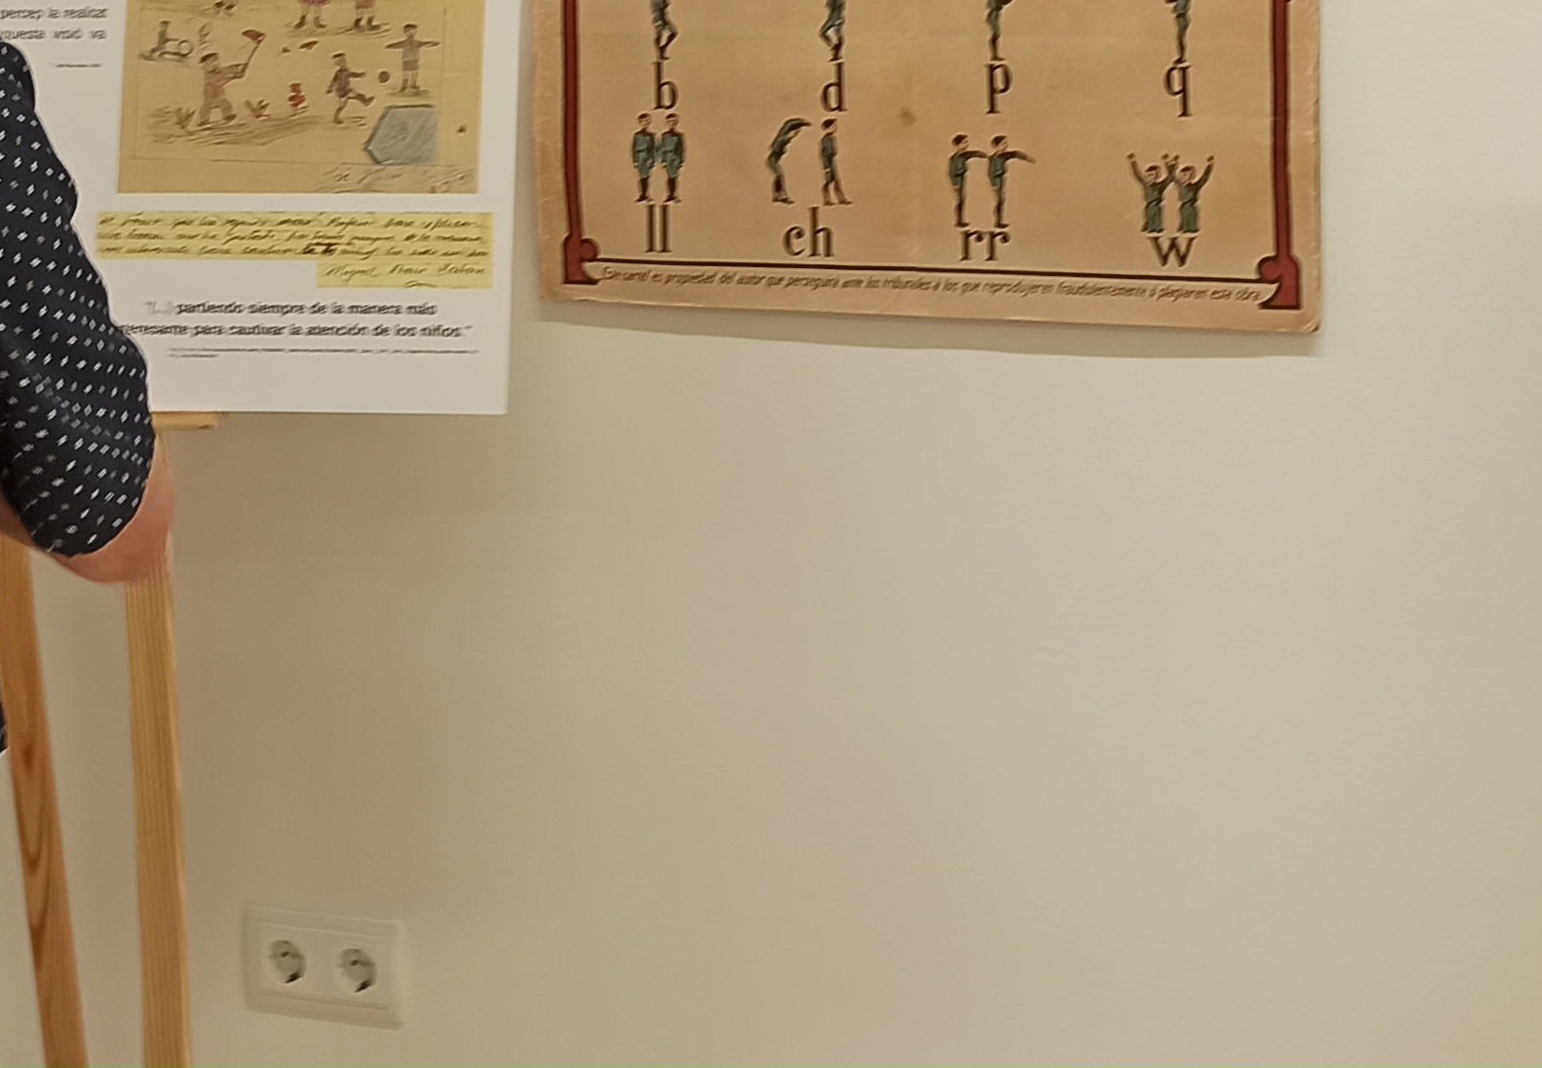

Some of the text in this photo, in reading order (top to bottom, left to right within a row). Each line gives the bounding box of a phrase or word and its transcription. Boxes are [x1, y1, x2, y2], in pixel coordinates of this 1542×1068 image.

[652, 60, 678, 111] b
[821, 62, 847, 113] d
[985, 63, 1011, 114] p
[1163, 63, 1192, 117] q
[782, 207, 834, 258] ch
[960, 227, 1010, 261] rr
[1150, 235, 1196, 268] w
